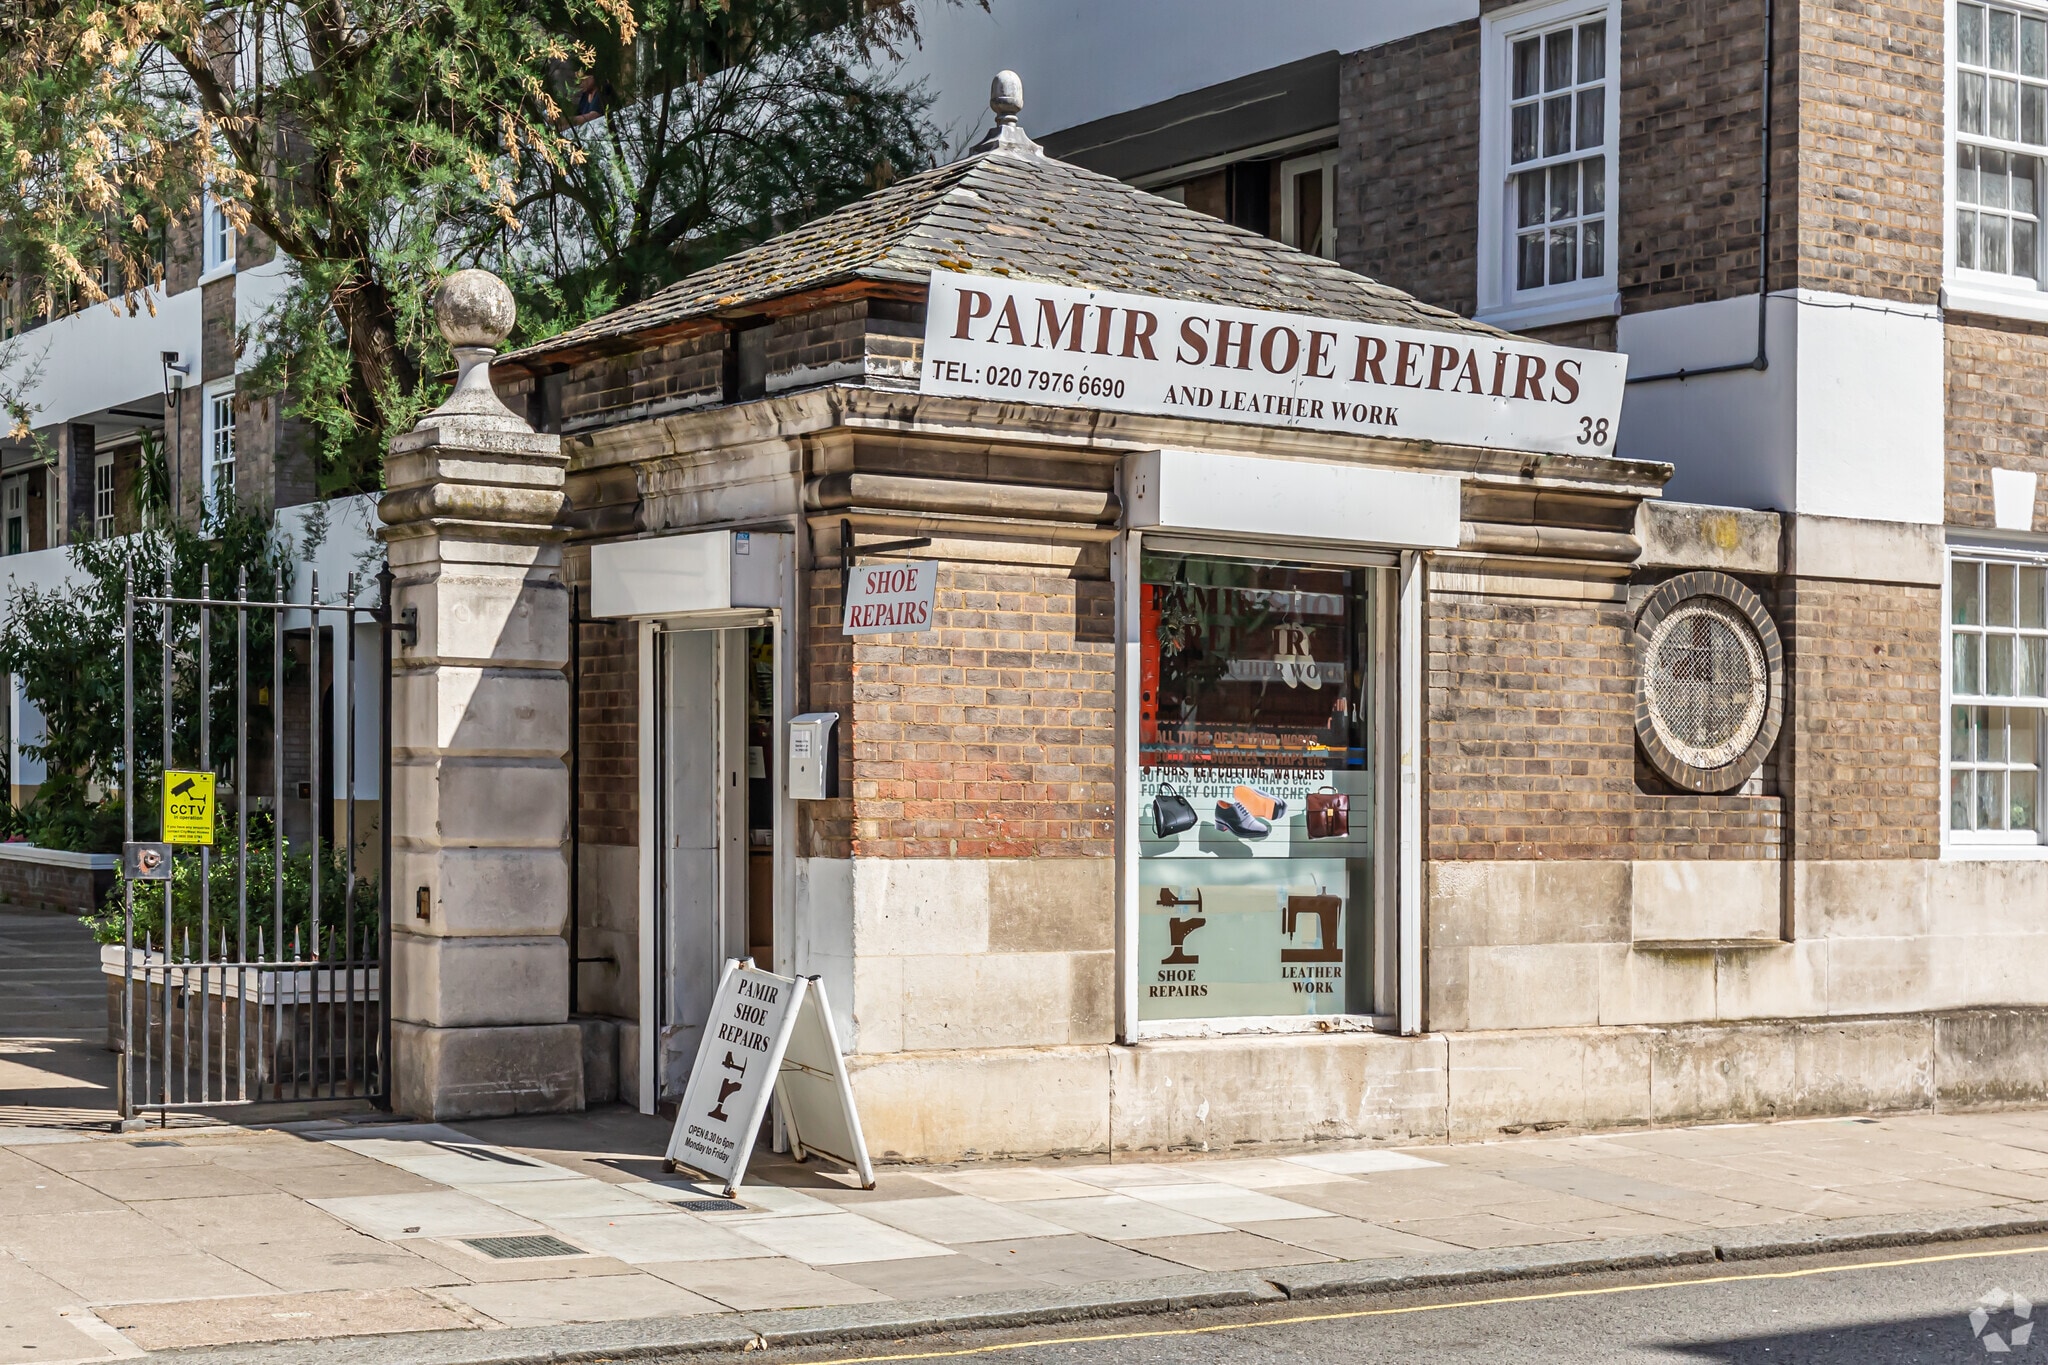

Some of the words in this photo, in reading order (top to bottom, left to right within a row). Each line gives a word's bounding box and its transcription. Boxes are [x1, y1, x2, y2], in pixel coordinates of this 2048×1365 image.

[950, 288, 1160, 361] PAMIR
[1176, 316, 1338, 379] SHOE
[1349, 335, 1582, 405] REPAIRS
[932, 359, 980, 384] TEL:
[986, 365, 1022, 388] 020
[1028, 370, 1074, 393] 7976
[1079, 375, 1125, 399] 6690
[1163, 385, 1213, 407] AND
[1219, 389, 1324, 420] LEATHER
[1332, 401, 1399, 427] WORK
[1576, 416, 1609, 446] 38
[865, 568, 919, 595] SHOE
[849, 600, 928, 628] REPAIRS
[1264, 752, 1304, 767] STRAPS
[170, 804, 206, 815] CCTV
[1157, 969, 1196, 982] SHOE
[1281, 966, 1342, 979] LEATHER
[738, 978, 779, 1004] PAMIR
[1149, 984, 1208, 998] REPAIRS
[1292, 981, 1334, 994] WORK
[733, 1002, 769, 1027] SHOE
[718, 1022, 771, 1053] REPAIRS
[685, 1136, 706, 1155] Monday
[705, 1145, 712, 1155] to
[711, 1147, 730, 1164] Friday
[688, 1124, 706, 1139] OPEN
[716, 1135, 723, 1145] to
[722, 1137, 735, 1150] 6pm
